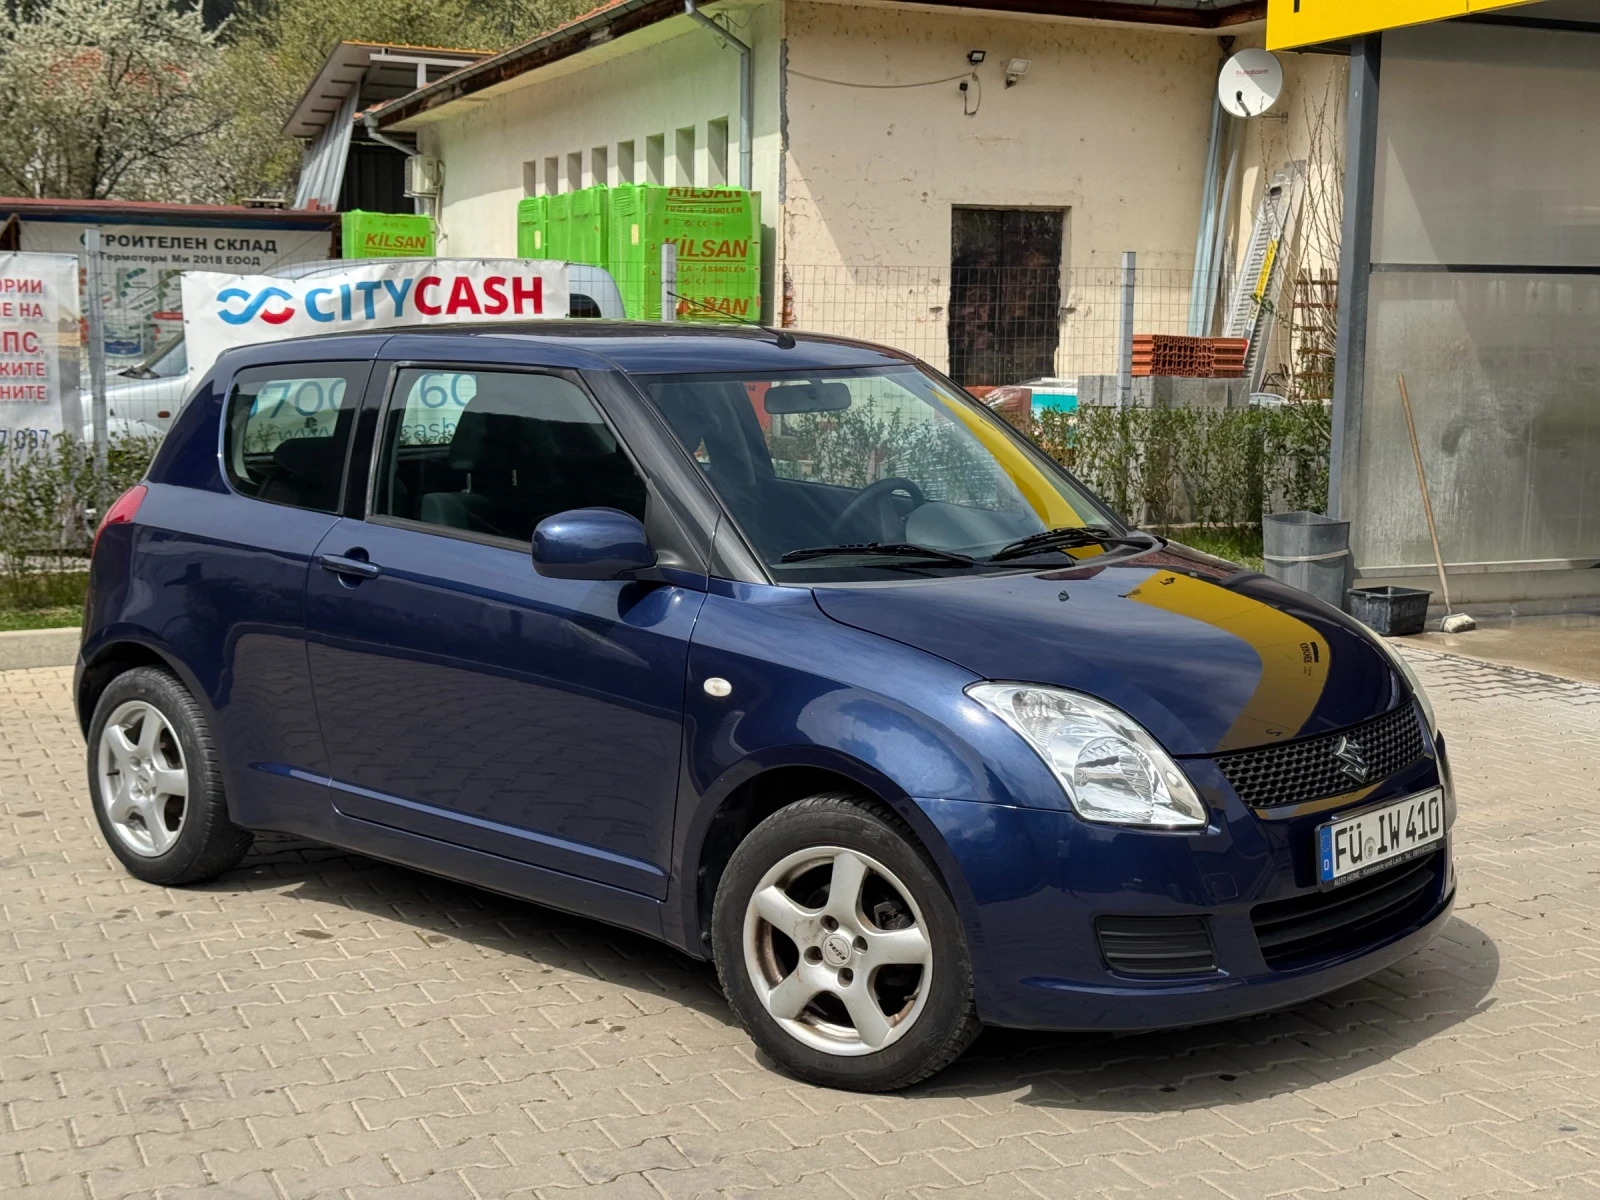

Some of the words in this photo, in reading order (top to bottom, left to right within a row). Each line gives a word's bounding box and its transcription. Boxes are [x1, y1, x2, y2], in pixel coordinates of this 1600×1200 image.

[214, 238, 277, 254] СКЛАД
[664, 234, 748, 258] İLSAN
[193, 255, 222, 264] 2018
[226, 256, 261, 266] ЕООД
[0, 278, 43, 294] РИИ
[19, 302, 44, 318] НА
[0, 385, 47, 399] НИТЕ
[1334, 822, 1363, 871] FÜ
[1377, 809, 1401, 855] IW
[1405, 796, 1439, 843] 410
[1323, 859, 1329, 871] D
